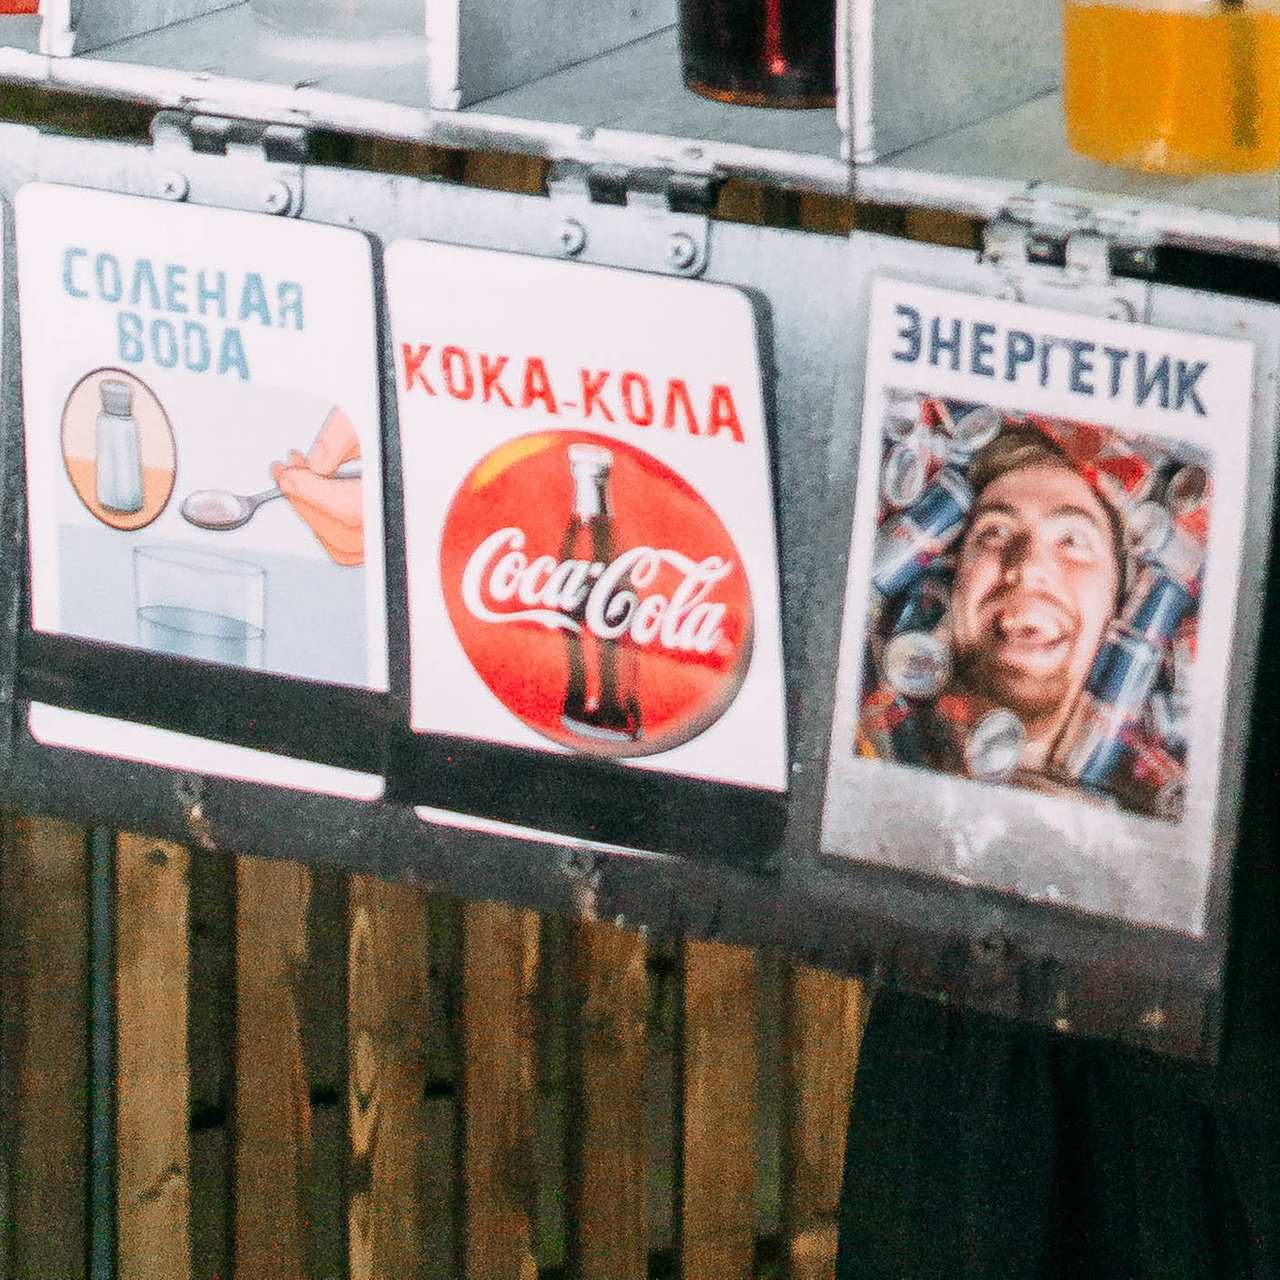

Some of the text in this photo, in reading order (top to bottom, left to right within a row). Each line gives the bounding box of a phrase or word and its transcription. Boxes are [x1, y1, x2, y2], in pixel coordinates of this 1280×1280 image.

[62, 246, 305, 331] СОЛЕНАЯ
[402, 342, 748, 444] КОКА-КОЛА
[891, 304, 1209, 417] ЭНЕРГЕТИК
